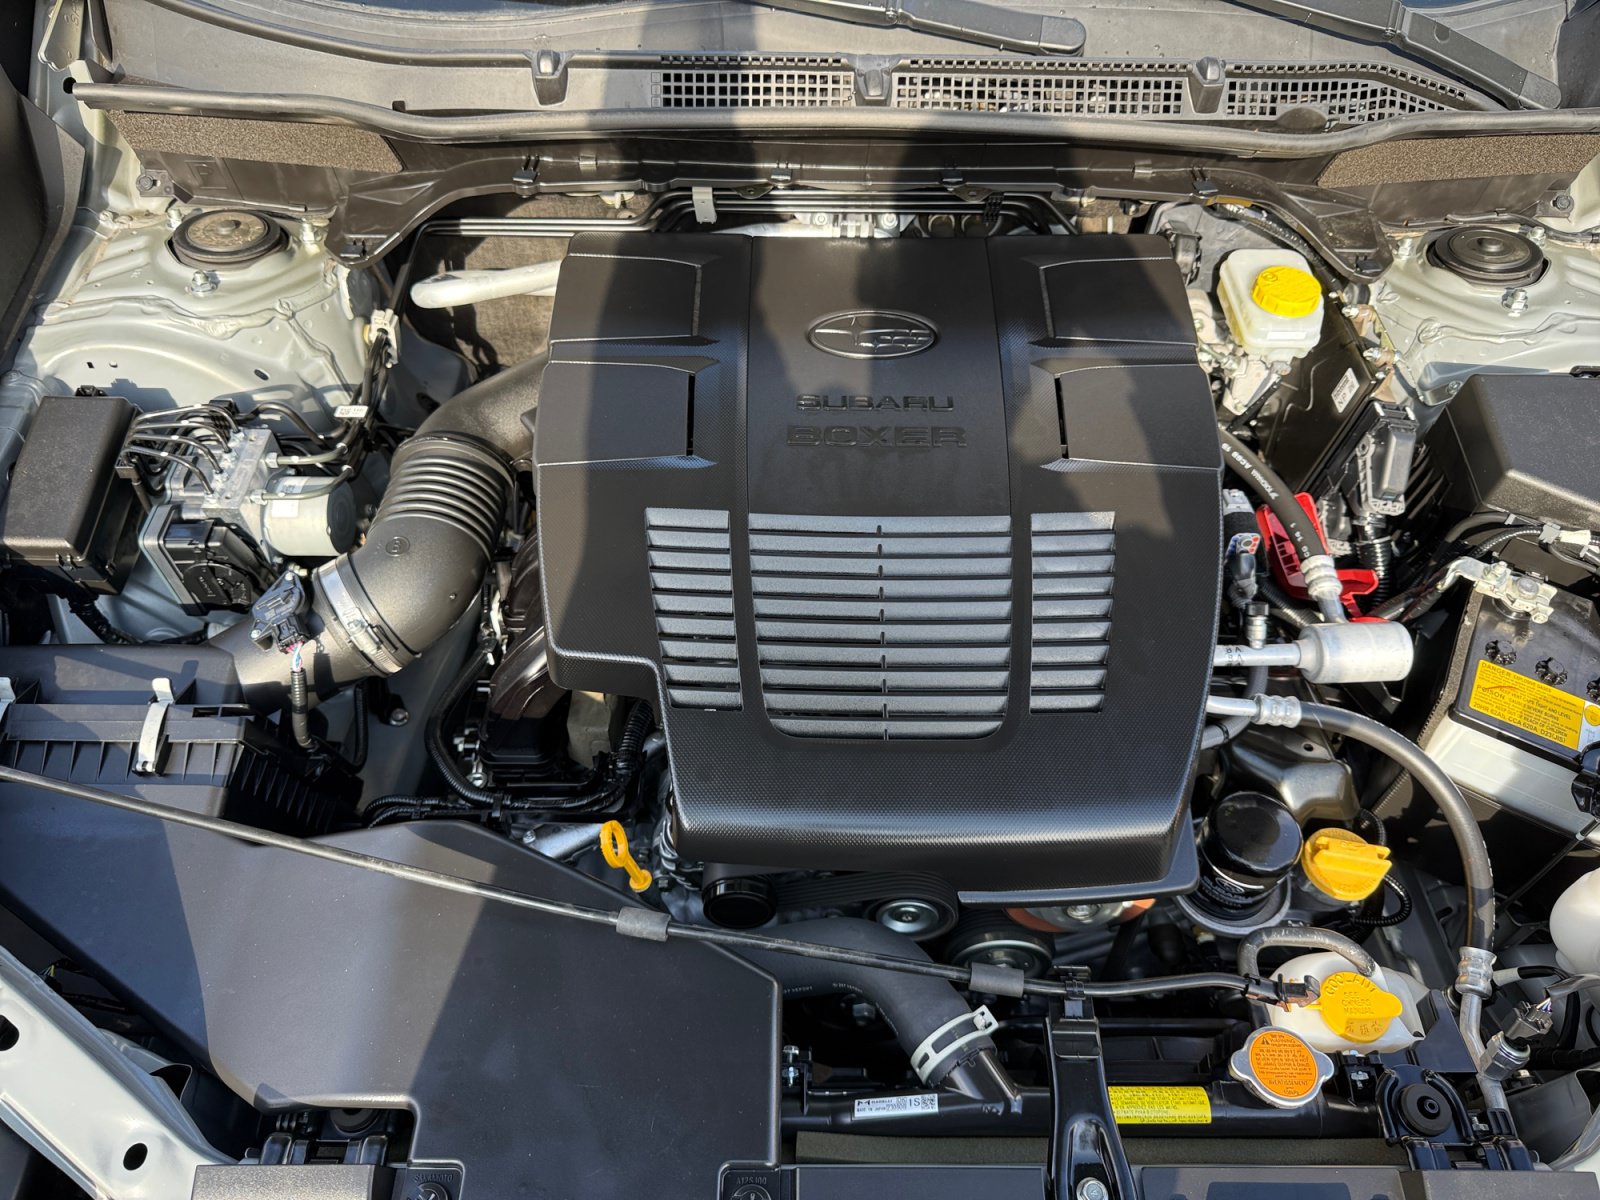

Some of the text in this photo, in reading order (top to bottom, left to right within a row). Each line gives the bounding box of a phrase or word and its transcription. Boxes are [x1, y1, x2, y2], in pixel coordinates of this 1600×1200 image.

[796, 394, 954, 412] SUBARU
[786, 425, 968, 449] BOXER
[1481, 662, 1512, 678] DANGER
[1477, 684, 1505, 700] POISON
[1508, 717, 1521, 725] CCA
[1324, 973, 1376, 996] COOLANT
